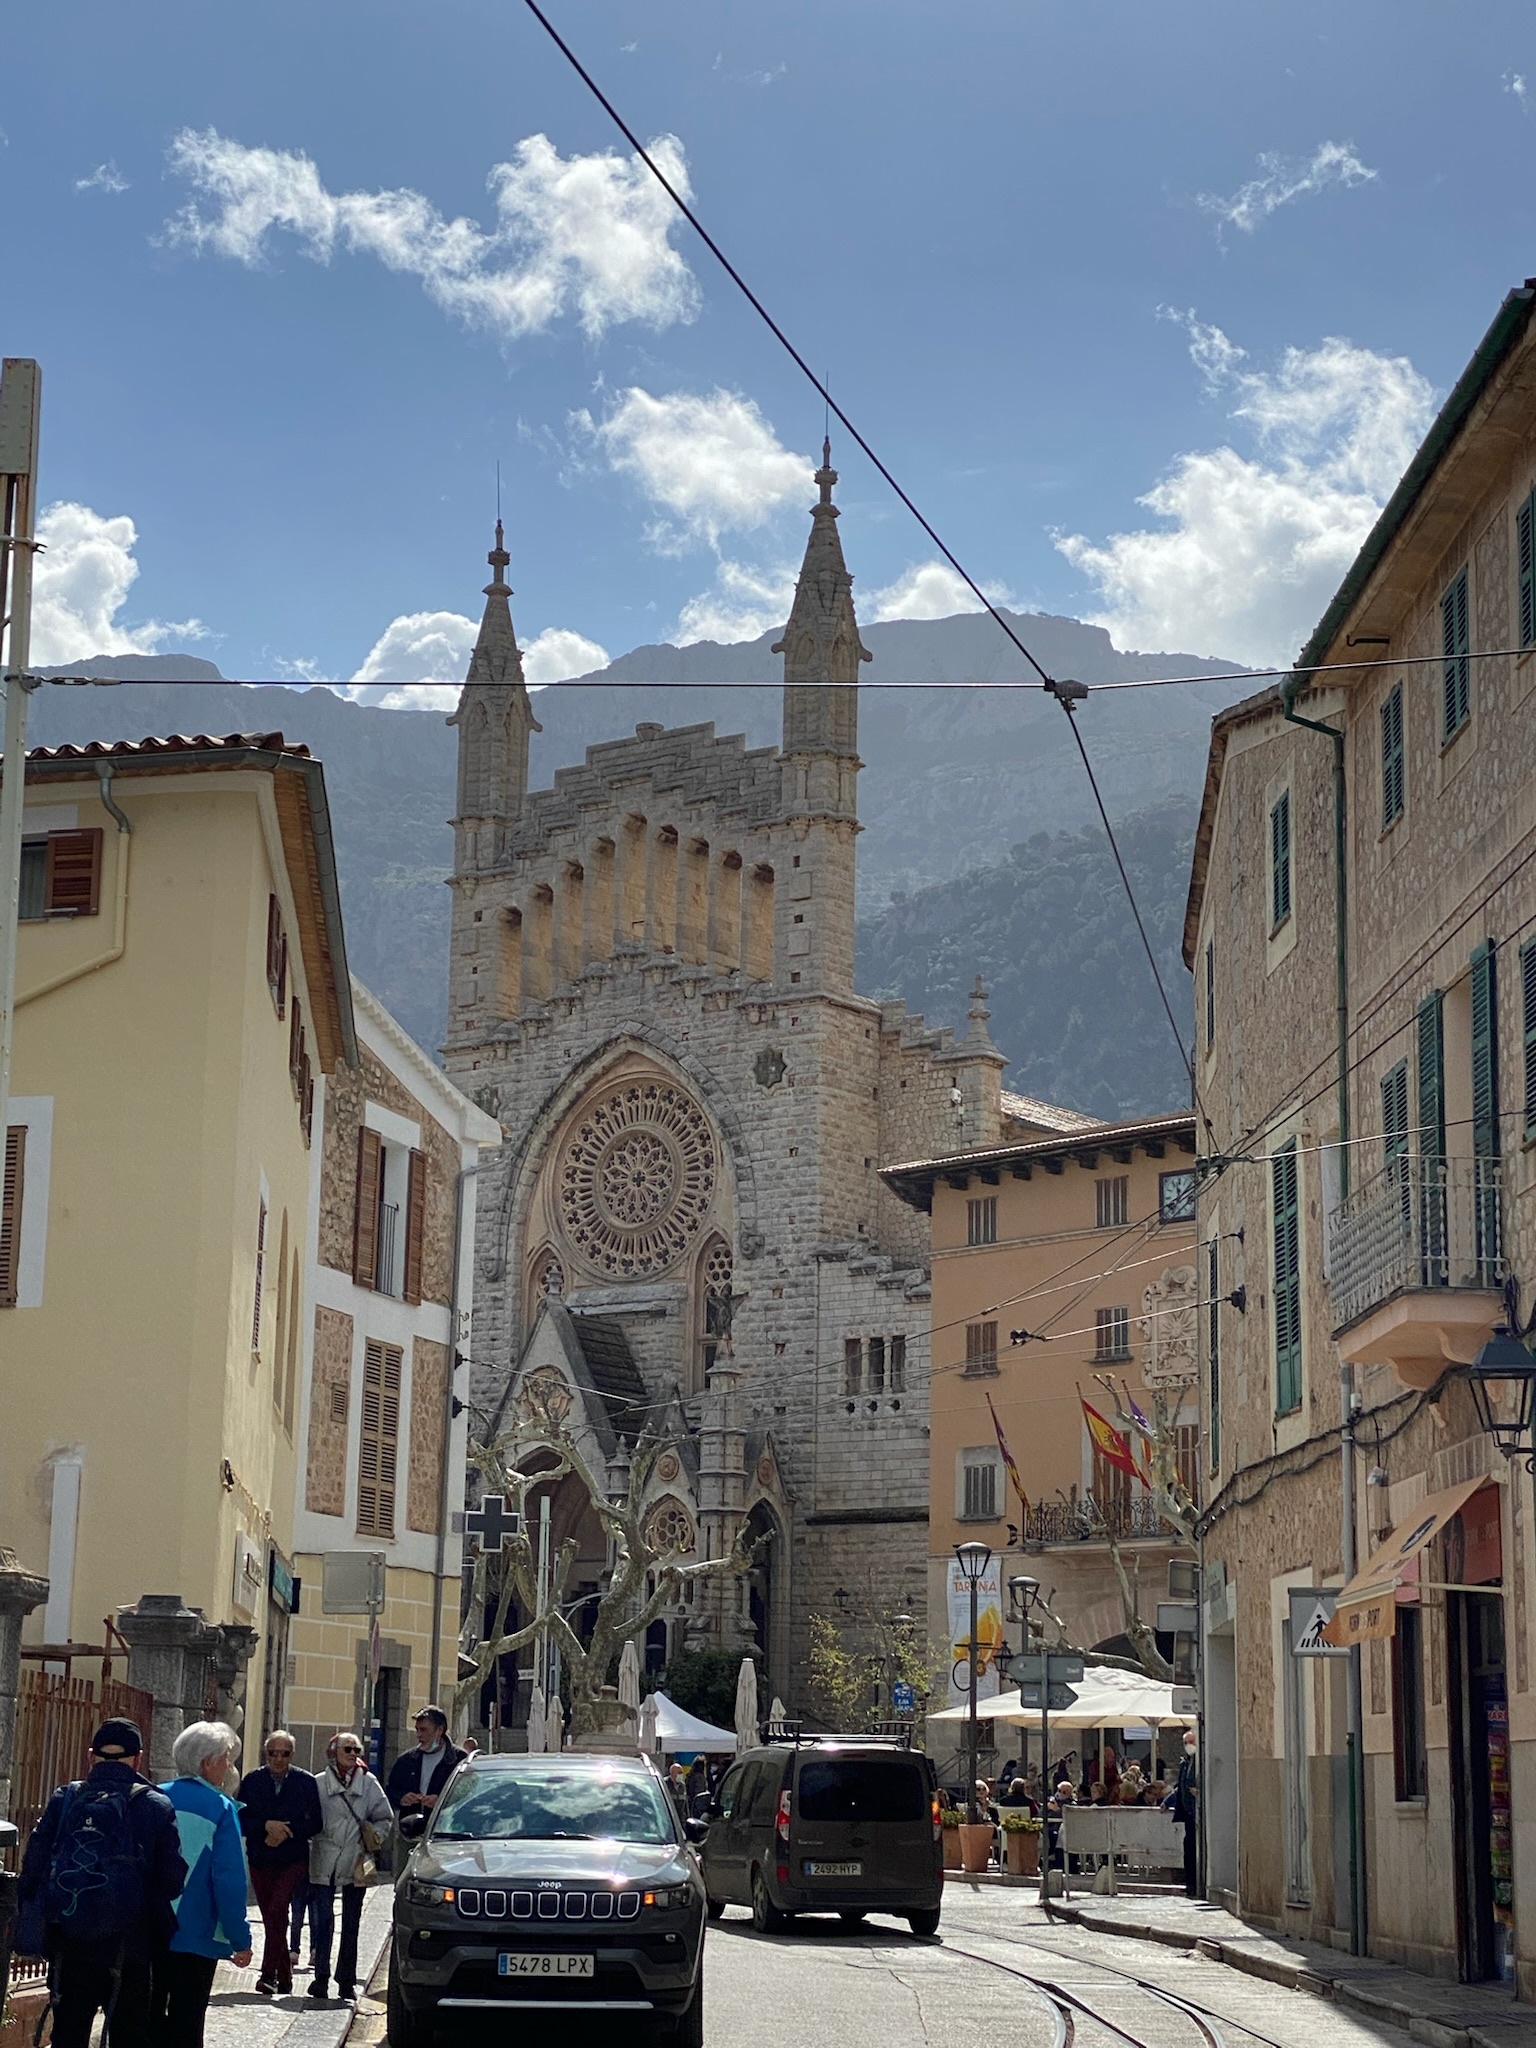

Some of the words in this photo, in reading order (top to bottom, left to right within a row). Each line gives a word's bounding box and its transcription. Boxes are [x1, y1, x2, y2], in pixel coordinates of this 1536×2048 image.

[953, 1580, 997, 1594] TARNJA
[814, 1864, 838, 1874] 2492
[840, 1864, 858, 1874] HYP
[537, 1881, 562, 1890] Jeep
[509, 1957, 551, 1973] 5478
[557, 1957, 589, 1974] LPX
